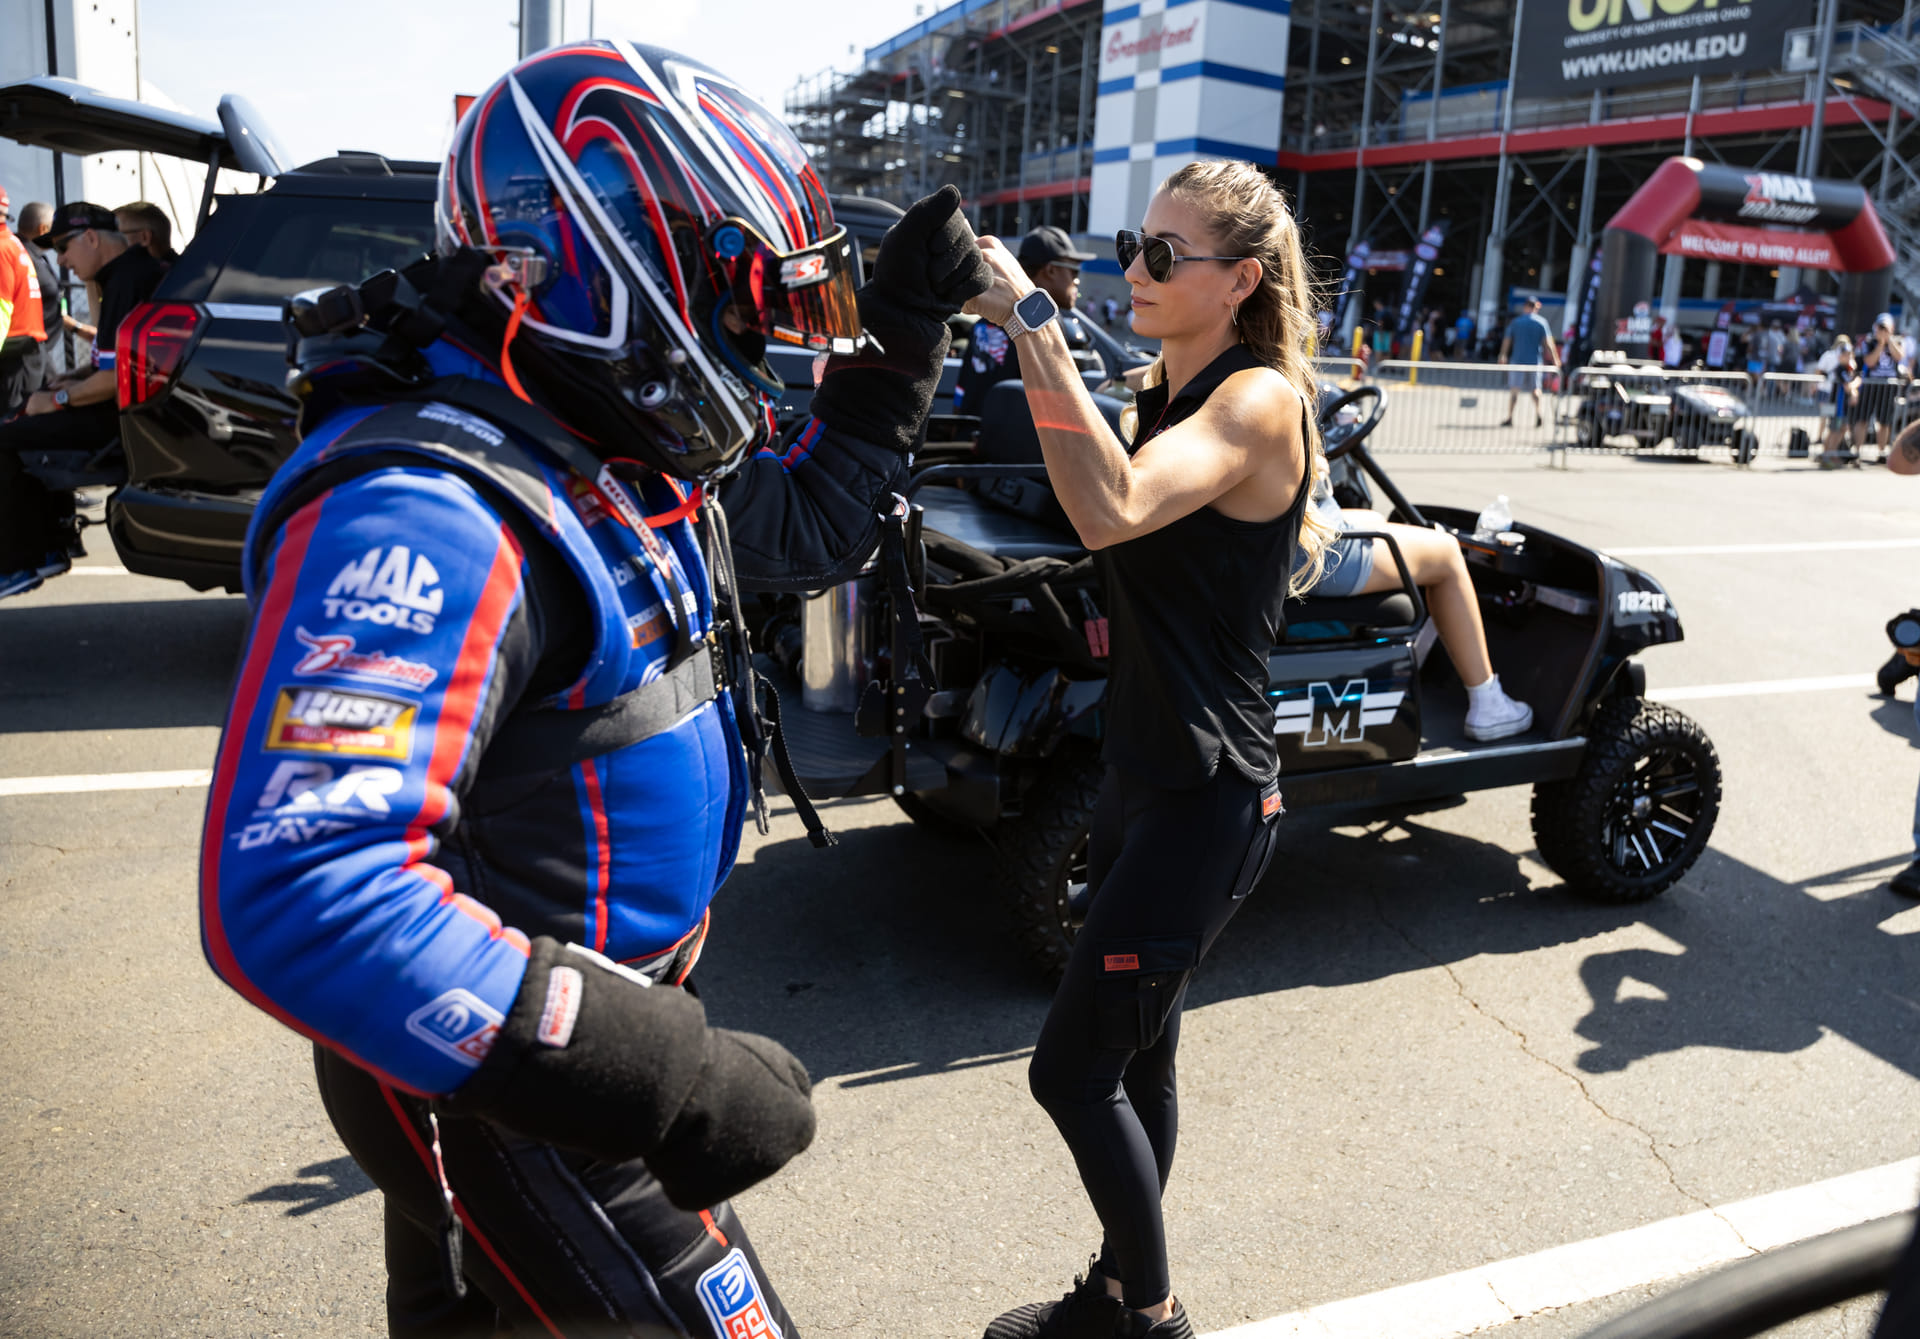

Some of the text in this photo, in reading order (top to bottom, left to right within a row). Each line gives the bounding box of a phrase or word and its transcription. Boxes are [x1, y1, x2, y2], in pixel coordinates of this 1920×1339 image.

[1564, 6, 1751, 48] UNIVERSITY OF NORTHWESTERN OHIO
[1562, 32, 1747, 80] WWW.UNOH.EDU
[1681, 234, 1739, 257] WELCOME
[1742, 242, 1757, 258] TO
[1759, 245, 1794, 261] NITRO
[326, 545, 444, 615] MAC
[322, 598, 436, 635] TOOLS
[289, 690, 406, 727] RUSH
[1303, 678, 1368, 746] M
